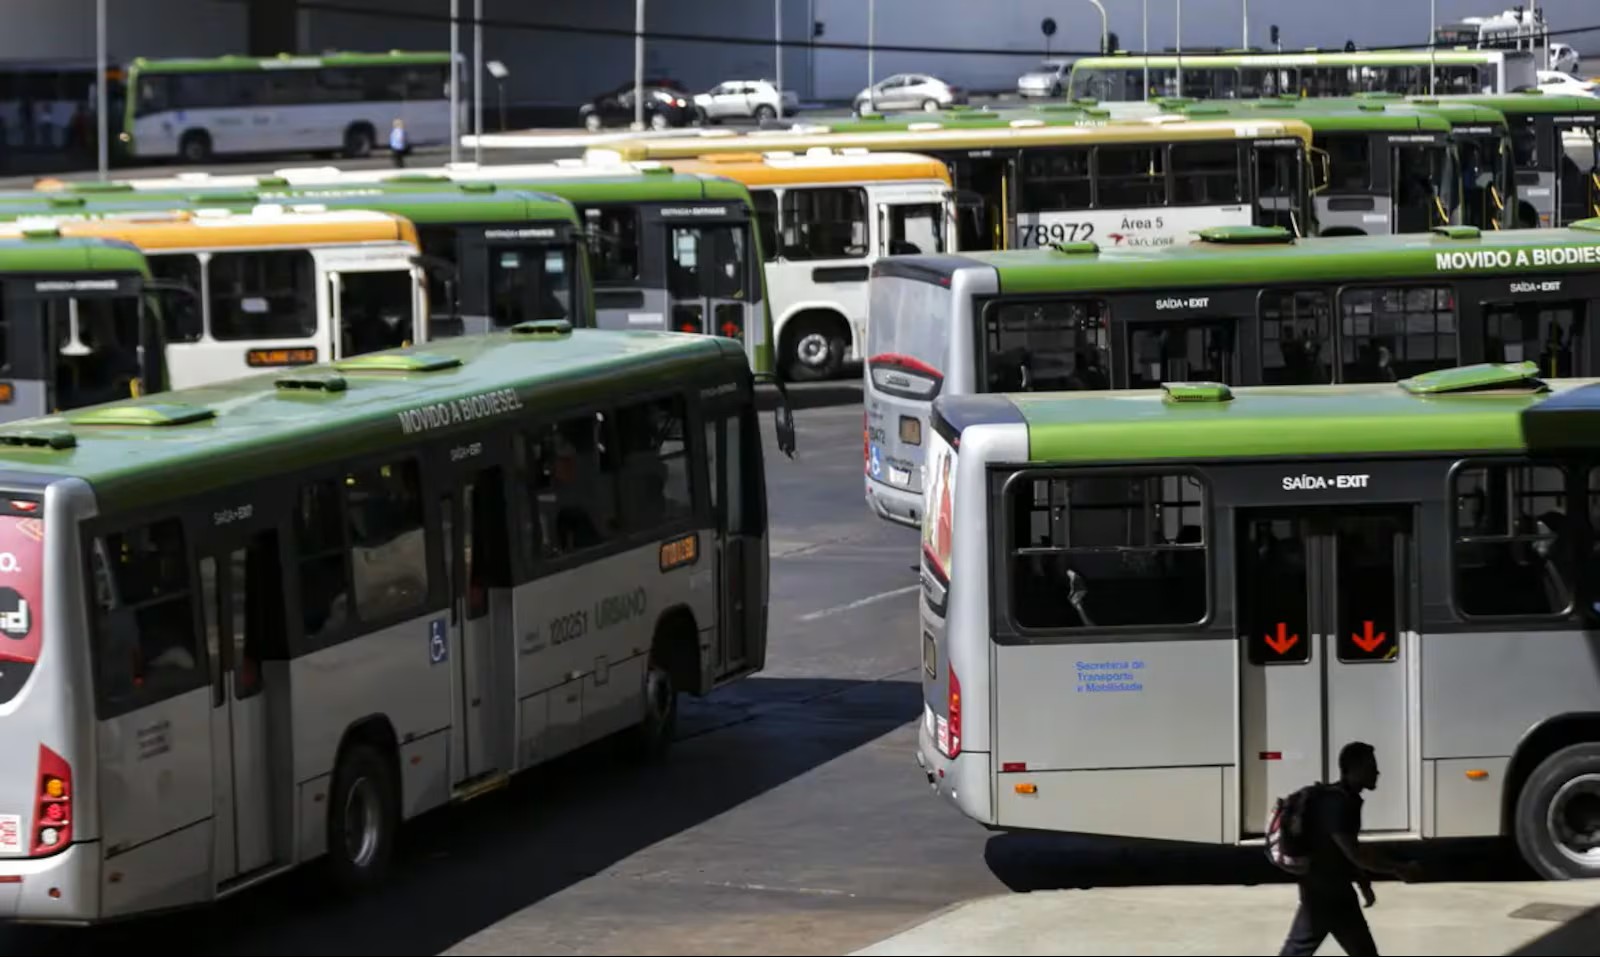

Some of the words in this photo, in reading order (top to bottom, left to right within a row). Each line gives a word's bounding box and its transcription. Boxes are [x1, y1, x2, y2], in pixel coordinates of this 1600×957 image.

[1121, 214, 1151, 229] Área
[1155, 216, 1164, 229] 5
[1019, 222, 1095, 247] 78972
[1435, 250, 1511, 270] MOVIDO
[1515, 249, 1530, 267] A
[1510, 281, 1537, 293] SAÍDA
[1541, 280, 1561, 291] EXIT
[1155, 297, 1184, 310] SAÍDA
[1188, 297, 1210, 309] EXIT
[398, 403, 450, 435] MOVIDO
[450, 401, 462, 423] A
[459, 387, 524, 421] BIODIESEL
[1282, 474, 1327, 490] SAÍDA
[1336, 474, 1370, 488] EXIT
